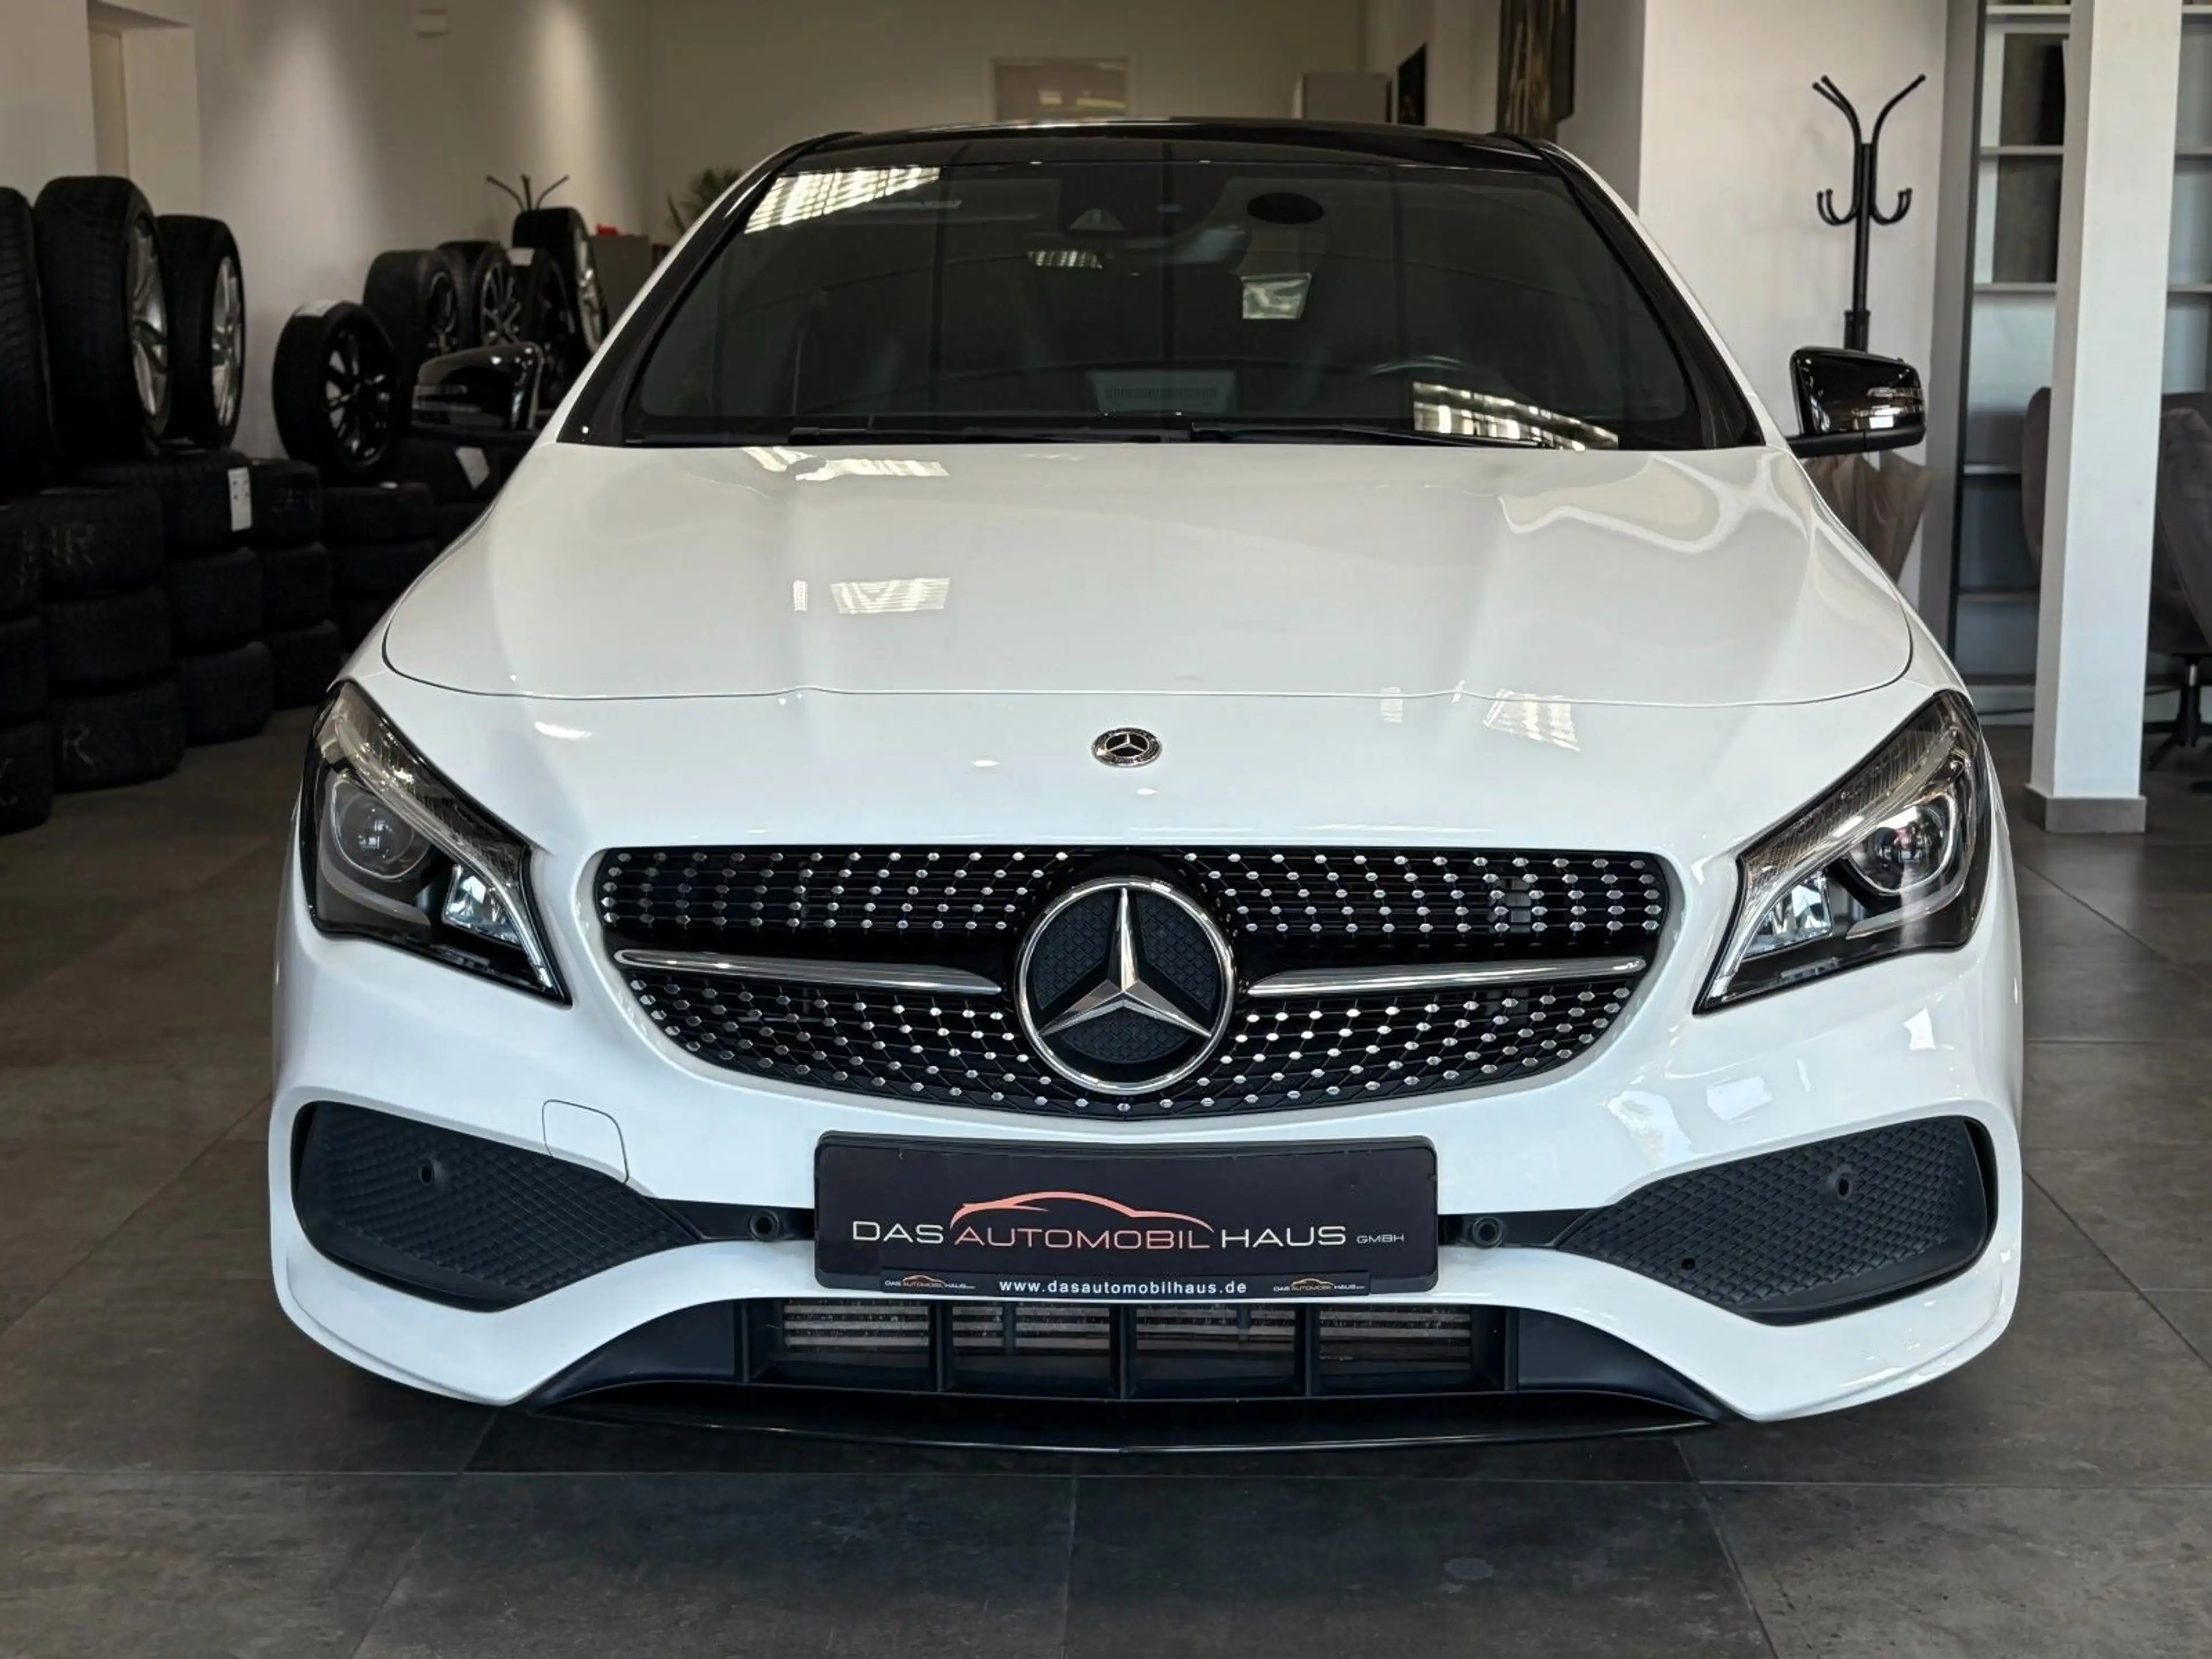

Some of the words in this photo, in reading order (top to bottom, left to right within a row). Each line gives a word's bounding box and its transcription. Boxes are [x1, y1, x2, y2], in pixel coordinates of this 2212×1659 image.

[853, 1221, 944, 1244] DAS
[955, 1226, 1210, 1250] AUTOMOBIL
[1222, 1226, 1346, 1248] HAUS
[1356, 1233, 1404, 1244] GMBH
[999, 1280, 1247, 1295] www.dasautomobilhaus.de
